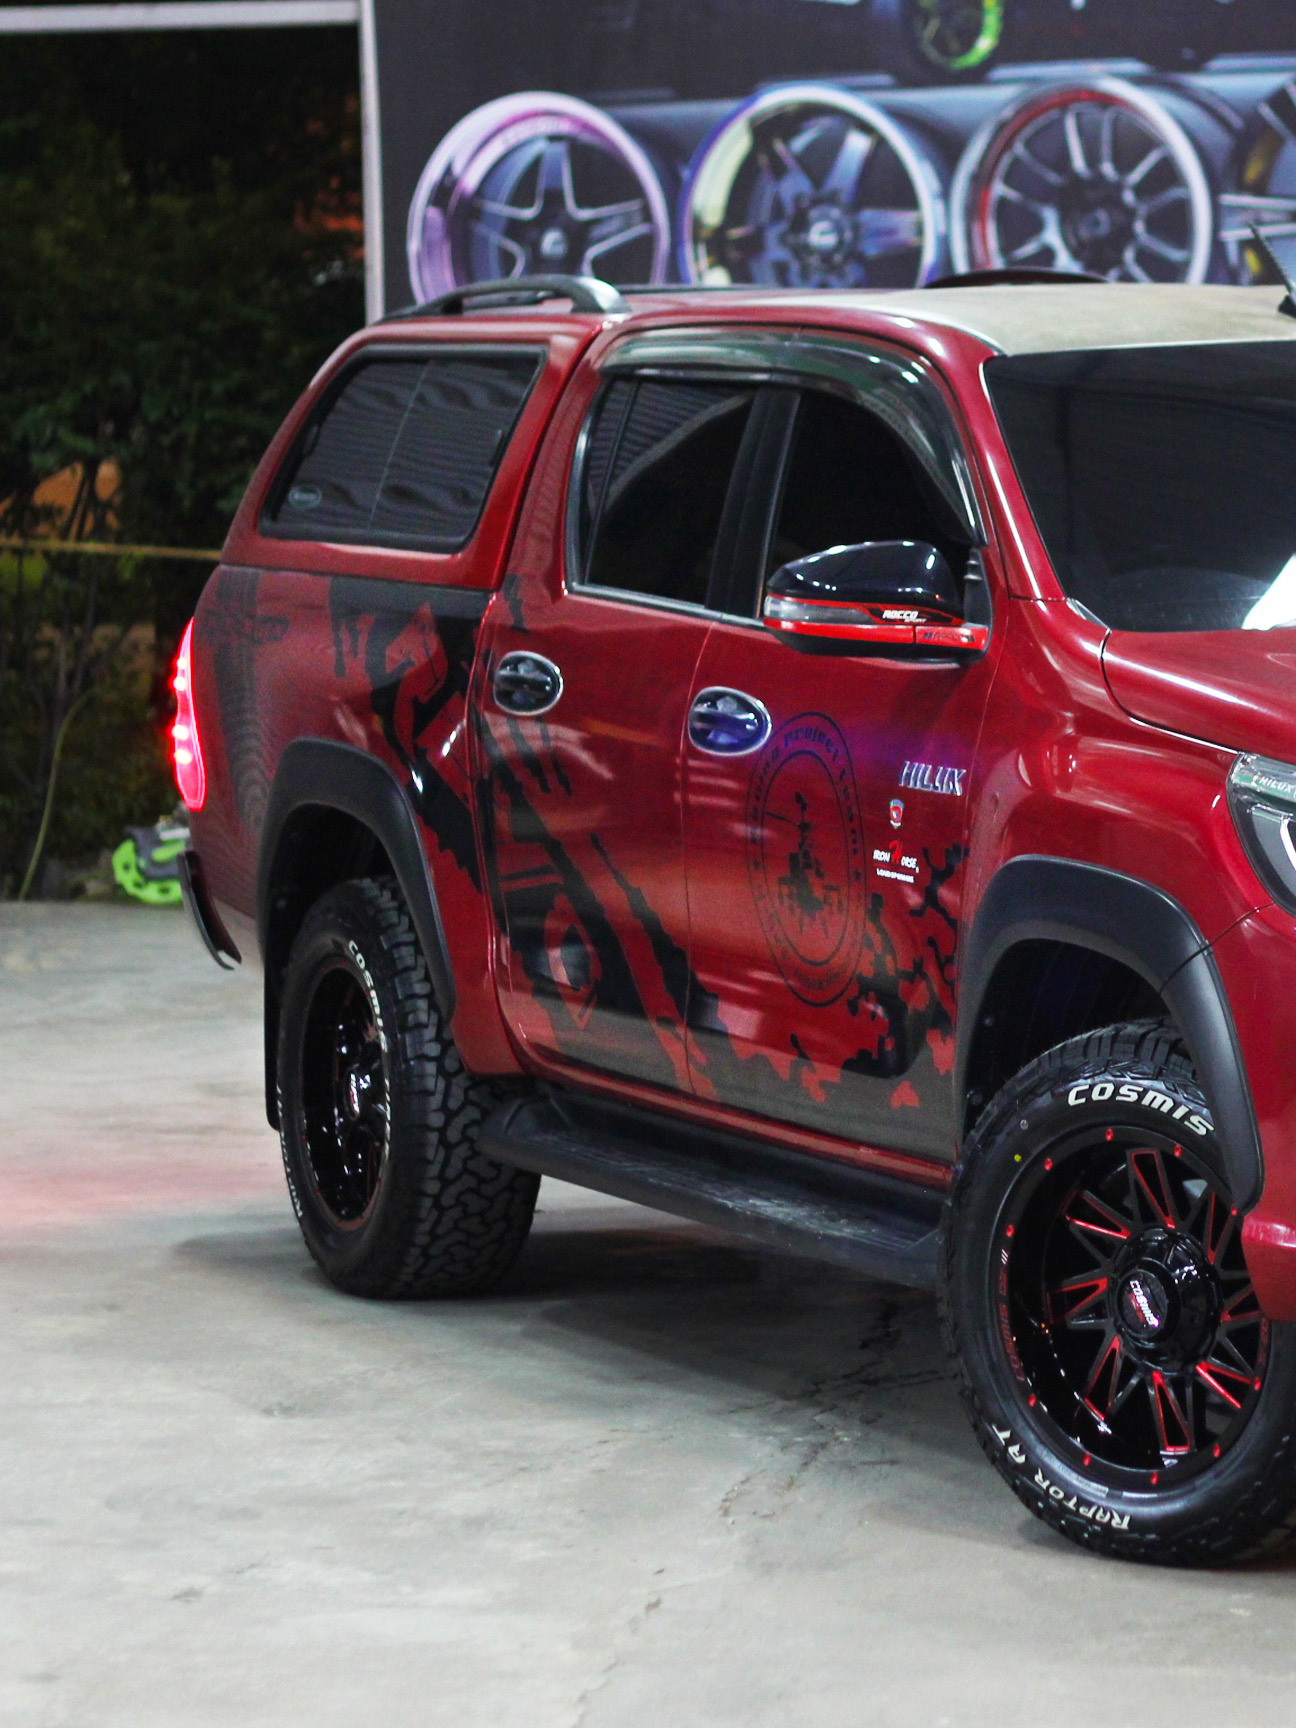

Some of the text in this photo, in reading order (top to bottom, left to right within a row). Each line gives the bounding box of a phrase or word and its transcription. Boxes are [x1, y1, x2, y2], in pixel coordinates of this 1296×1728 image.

[882, 610, 919, 619] ROCCO
[899, 761, 967, 796] HILUX
[1259, 776, 1294, 793] HILUX
[873, 849, 891, 862] IRON
[348, 940, 388, 1053] COSMIS
[1068, 1083, 1215, 1136] COSMIS
[1130, 1280, 1160, 1327] COSMIS
[1034, 1467, 1131, 1530] RAPTOR
